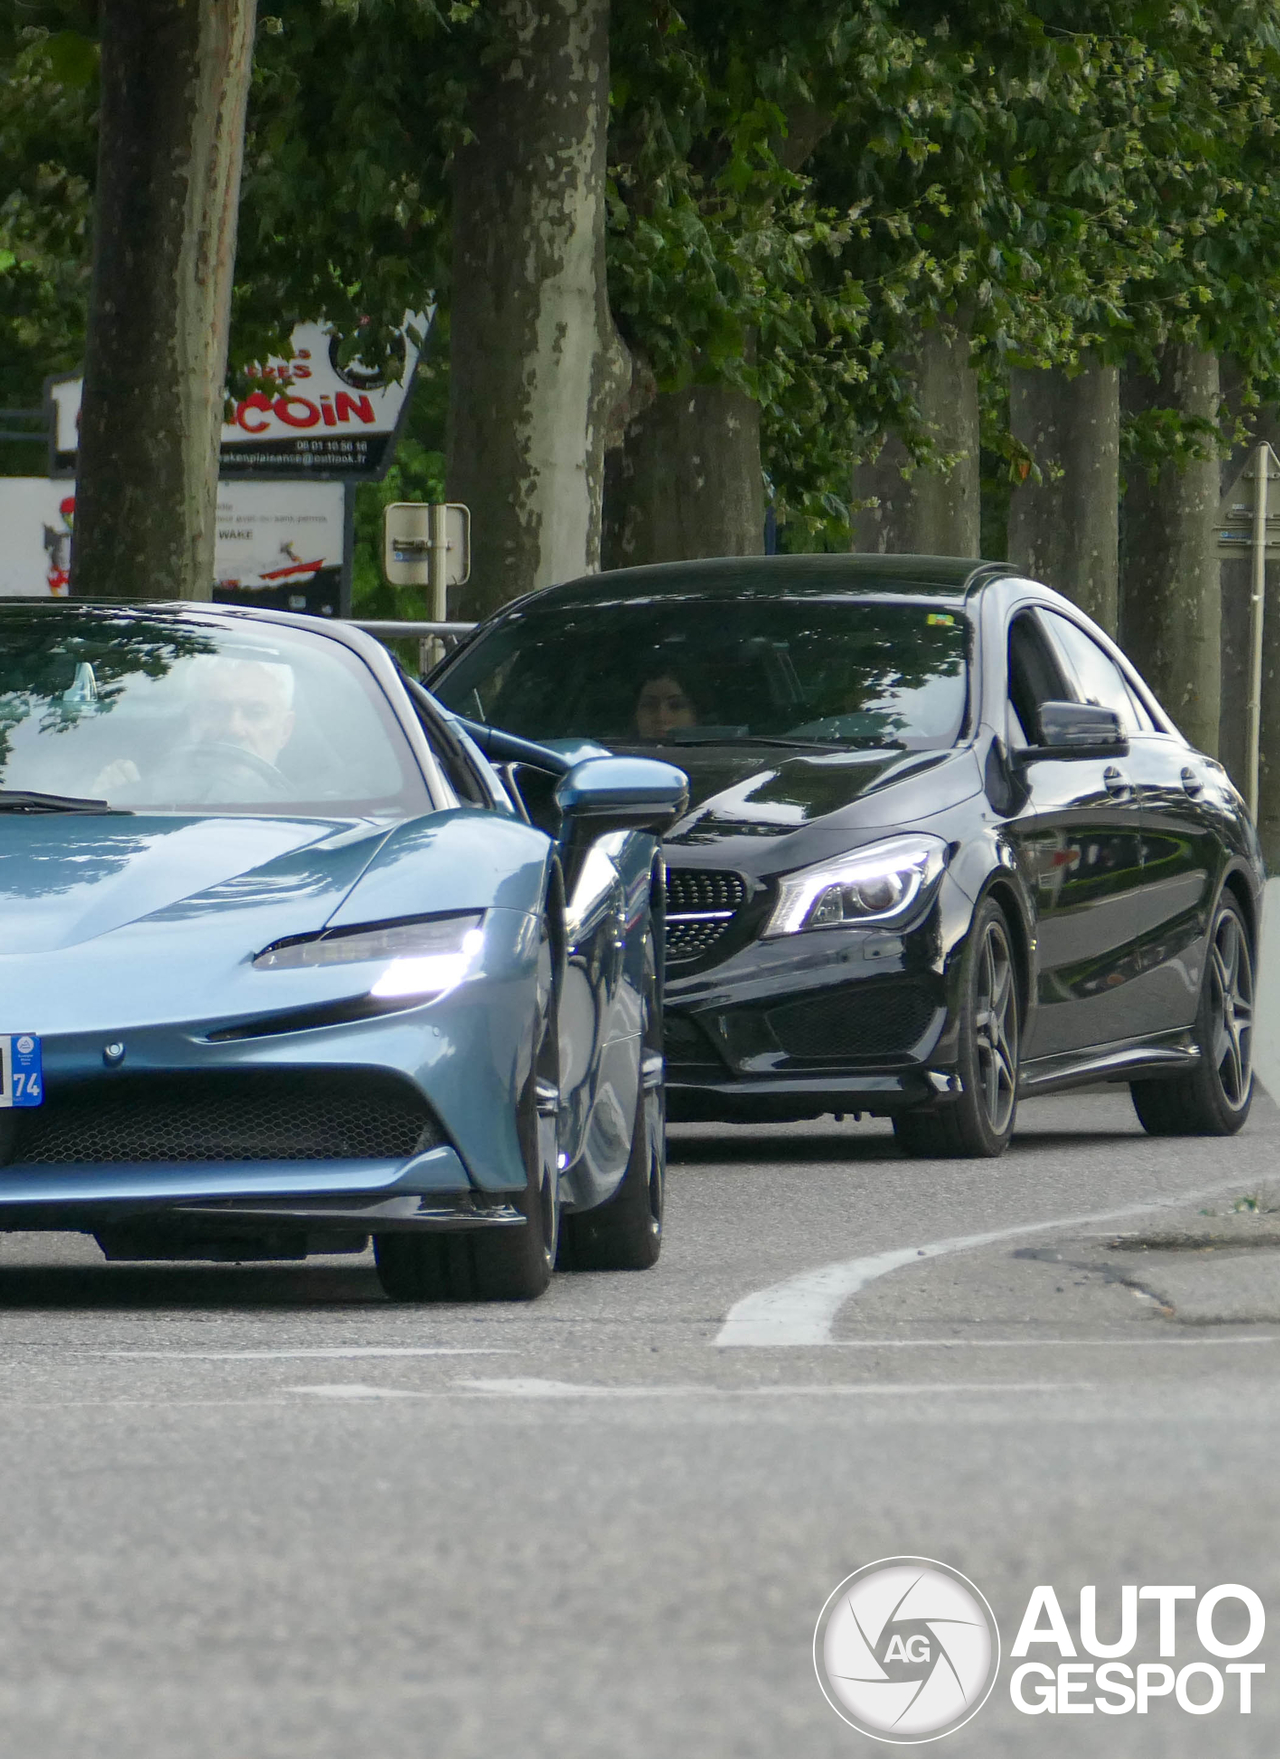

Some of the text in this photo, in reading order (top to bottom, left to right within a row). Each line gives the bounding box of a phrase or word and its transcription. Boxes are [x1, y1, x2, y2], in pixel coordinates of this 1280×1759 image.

[229, 391, 376, 434] COiN
[219, 529, 253, 540] WAKE
[13, 1073, 40, 1097] 74
